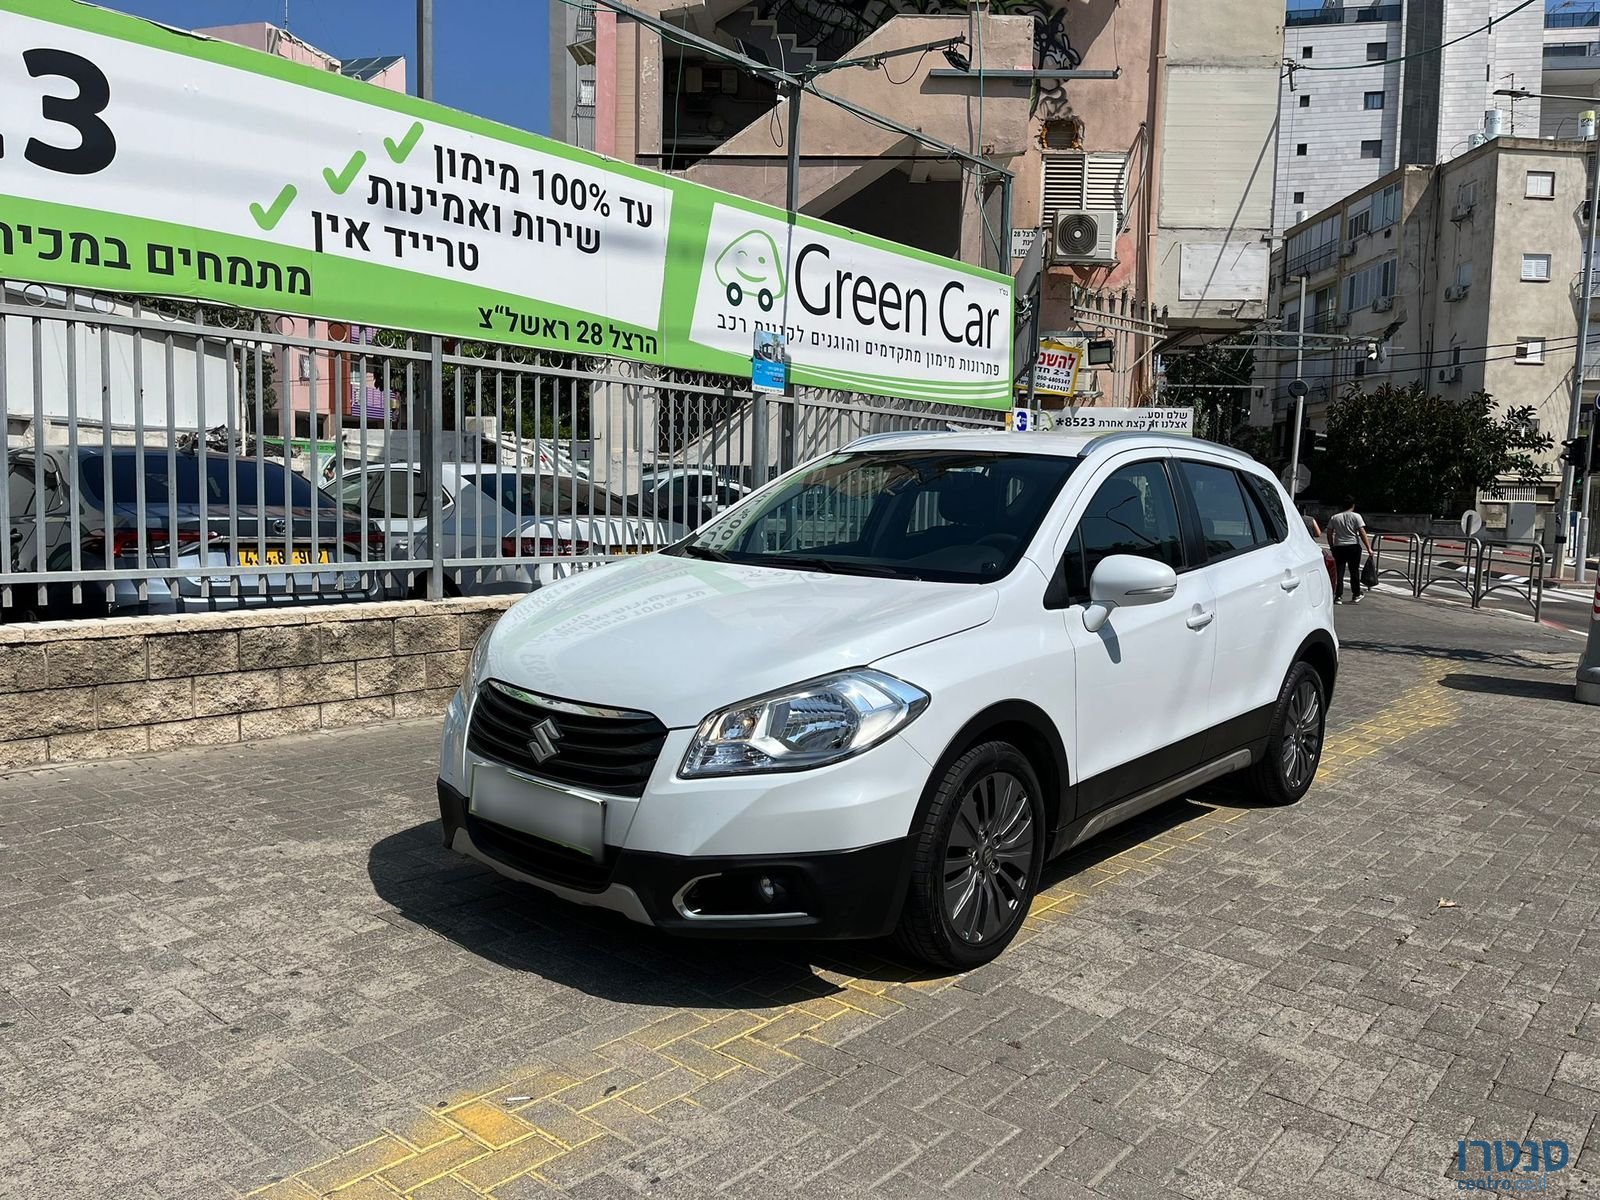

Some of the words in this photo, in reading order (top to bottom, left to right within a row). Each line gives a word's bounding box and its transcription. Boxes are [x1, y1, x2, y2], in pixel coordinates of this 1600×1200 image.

[0, 48, 116, 175] 3
[434, 145, 520, 193] מימון
[367, 175, 501, 233] ואמינות
[533, 169, 611, 217] 100%
[619, 196, 653, 228] עד
[311, 211, 371, 253] אין
[513, 210, 601, 254] שירות
[384, 225, 479, 271] טרייד
[147, 243, 312, 296] מתמחים
[795, 243, 927, 336] Green
[939, 281, 999, 349] Car
[576, 321, 602, 346] 28
[717, 313, 746, 333] רכב
[609, 324, 657, 354] הרצל
[811, 331, 859, 353] והוגנים
[865, 341, 921, 363] מתקדמים
[926, 352, 955, 368] מימון
[959, 358, 1000, 376] פתרונות
[1098, 420, 1123, 428] אחרת
[1126, 420, 1146, 429] קצת
[1161, 420, 1188, 428] אצלנו
[1167, 410, 1188, 419] שלם
